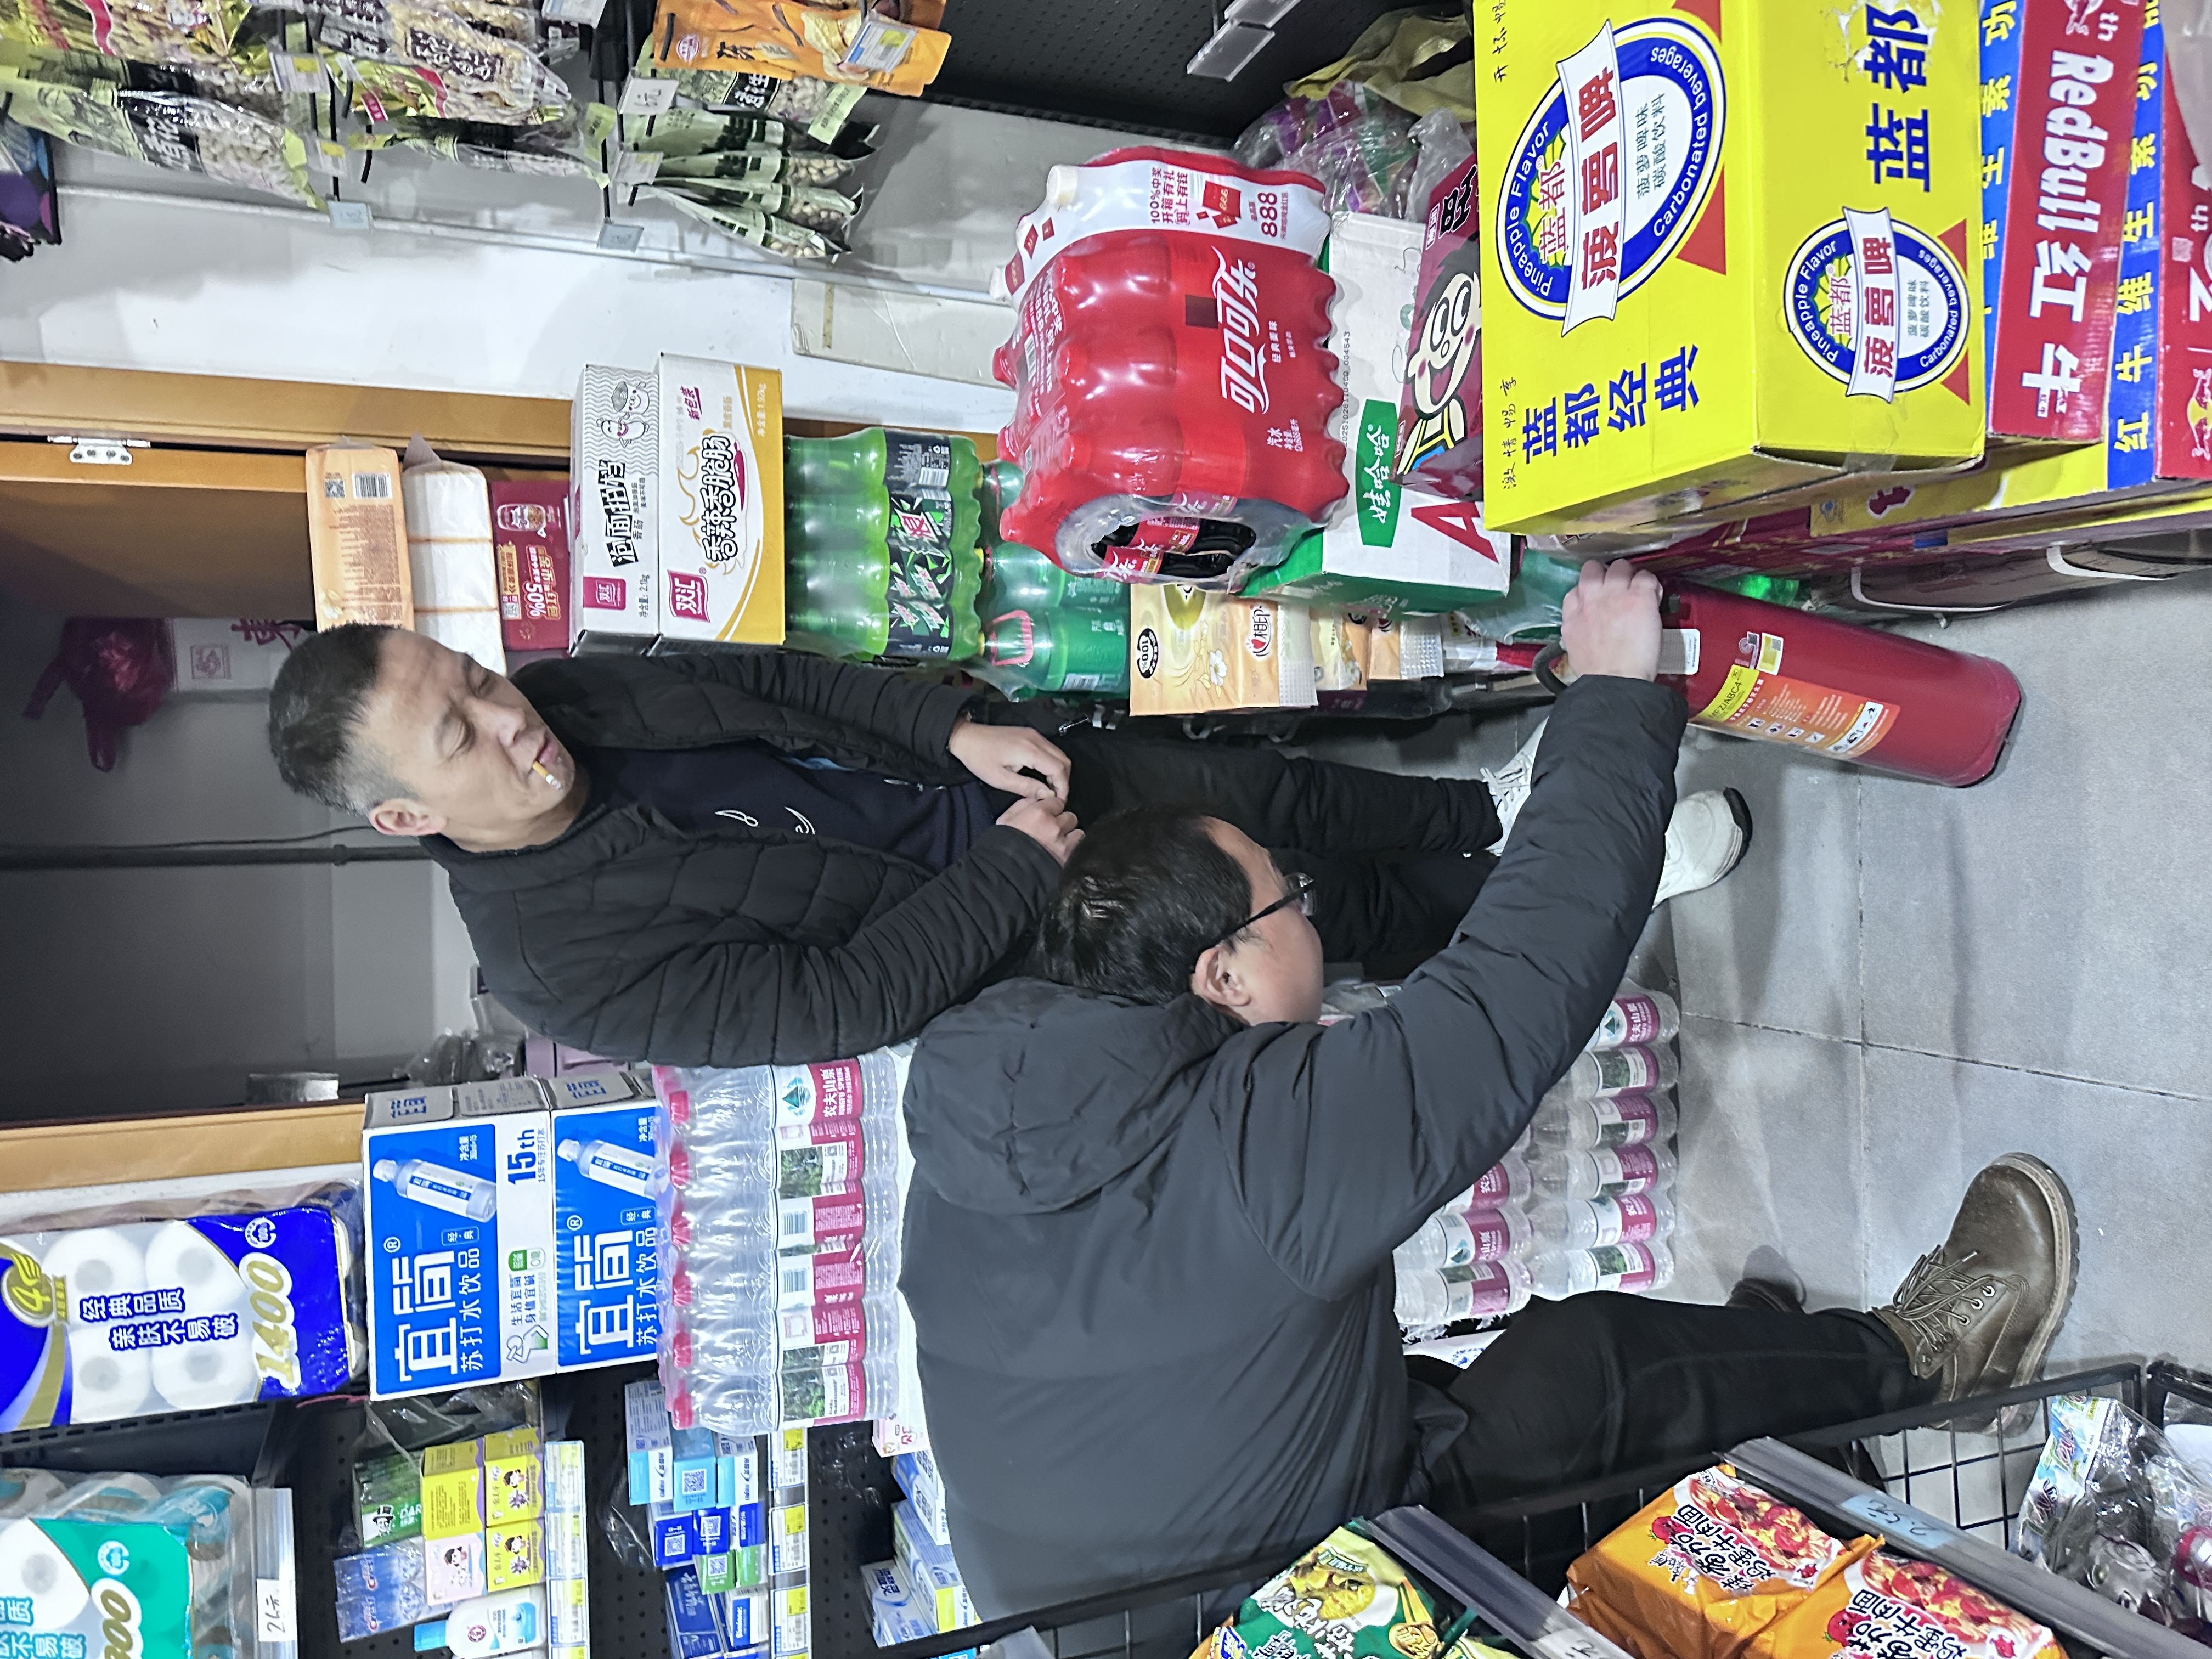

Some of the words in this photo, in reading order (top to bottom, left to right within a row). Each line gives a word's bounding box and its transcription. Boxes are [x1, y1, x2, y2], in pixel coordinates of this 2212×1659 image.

[1649, 45, 1707, 108] beverages
[1864, 2, 1931, 193] 蓝都
[1510, 120, 1550, 199] Flavor
[1578, 66, 1619, 290] 菠萝啤
[1635, 102, 1651, 199] 菠萝啤味
[1651, 92, 1667, 190] 碳酸饮料
[1652, 111, 1708, 237] Carbonated
[2036, 50, 2115, 233] RedBull
[1149, 166, 1162, 224] 100%中奖
[1160, 170, 1175, 224] 开箱有礼
[1175, 171, 1190, 225] 码上有钱
[1256, 191, 1278, 238] 888
[1537, 160, 1568, 262] 蓝都
[1506, 205, 1554, 296] Pineapple
[1799, 240, 1838, 278] Flavor
[1916, 249, 1959, 306] beverages
[1210, 244, 1270, 414] 可口可乐
[1268, 320, 1282, 364] 经典美味
[1795, 283, 1839, 363] Pineapple
[1828, 276, 1853, 338] 蓝都
[1862, 235, 1895, 378] 菠萝啤
[1907, 279, 1918, 337] 菠萝啤味
[1918, 279, 1931, 338] 碳酸饮料
[1918, 309, 1960, 369] Carbonated
[2021, 238, 2092, 419] 红牛
[1266, 427, 1283, 448] 汽水
[1522, 344, 1700, 465] 蓝都经典
[599, 460, 636, 563] 泡面拍档
[700, 433, 738, 562] 香辣香脆肠
[1362, 426, 1392, 524] 娃哈哈
[633, 520, 644, 540] 香肠
[674, 577, 697, 614] 双汇
[1624, 1002, 1641, 1043] 农夫山泉
[820, 1068, 837, 1118] 农夫山泉
[507, 1128, 537, 1185] 15th
[82, 1288, 183, 1321] 经典品质
[247, 1260, 294, 1383] 1400
[392, 1249, 458, 1381] 宜简
[457, 1248, 483, 1373] 苏打水饮品
[574, 1229, 634, 1355] 宜简
[636, 1226, 658, 1346] 苏打水饮品
[111, 1314, 238, 1349] 亲肤不易破
[1675, 1503, 1776, 1582] 鸡蛋牛肉面
[0, 1599, 31, 1624] 质
[1260, 1585, 1354, 1659] 菇炖鸡
